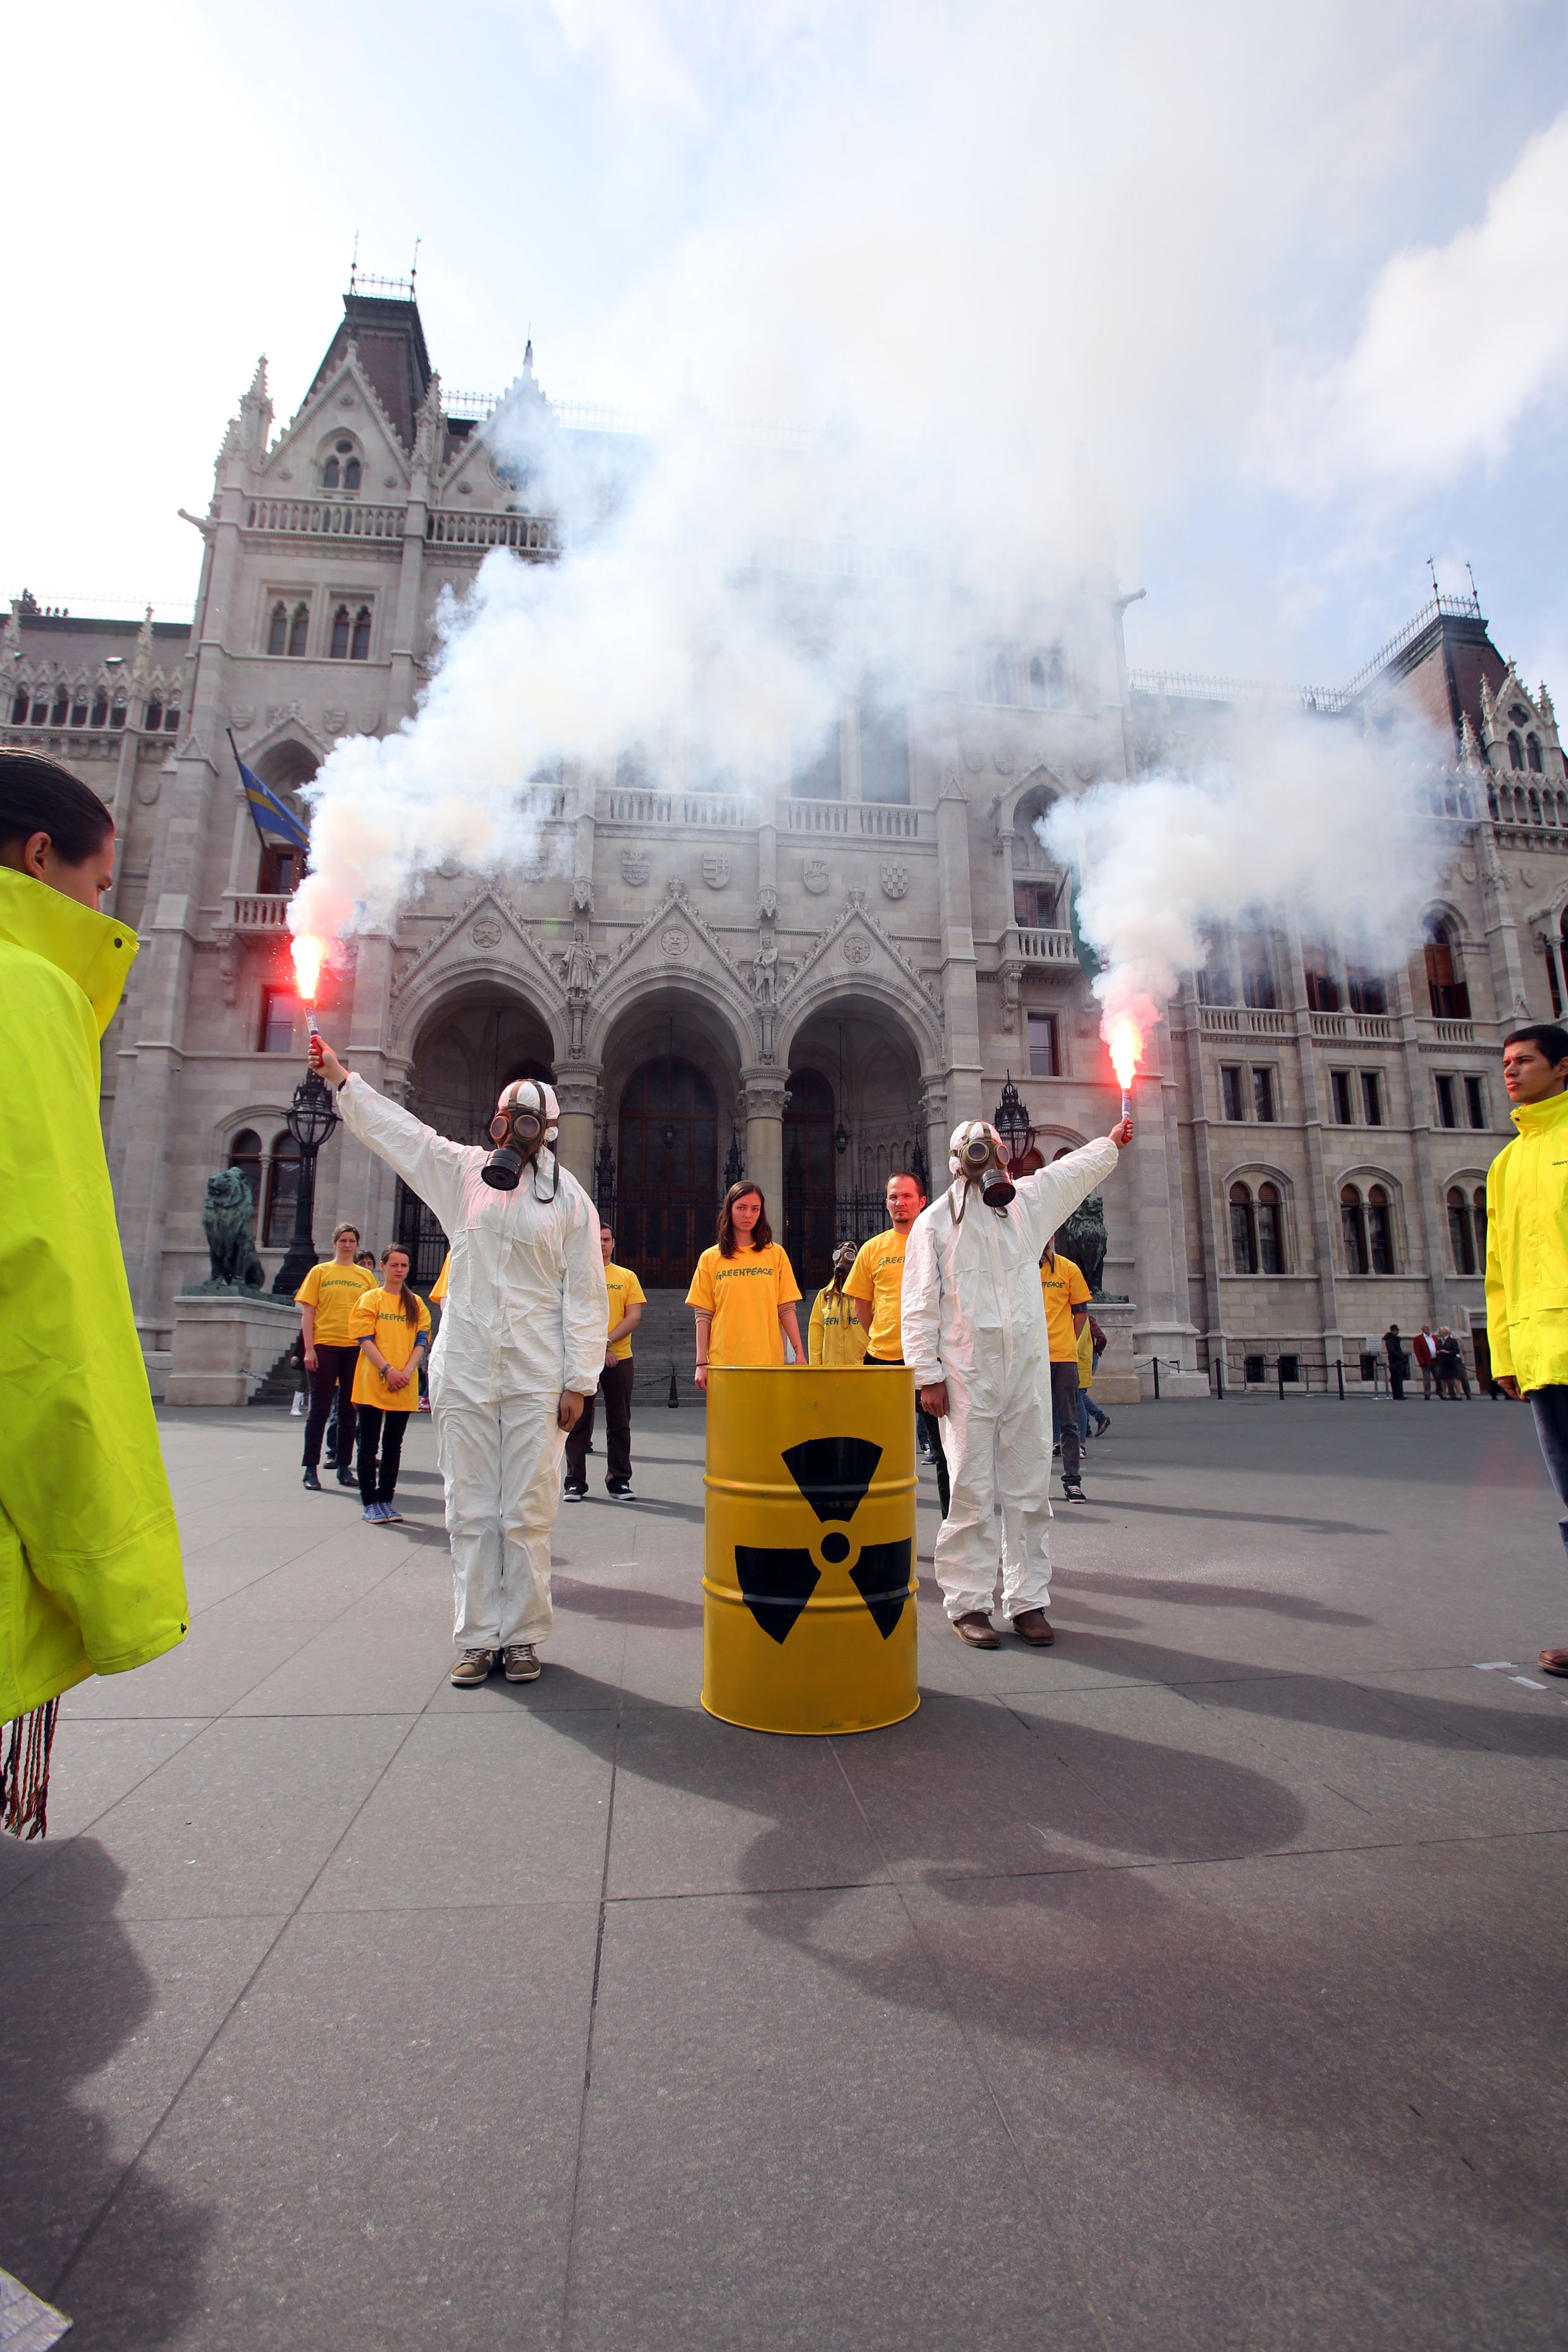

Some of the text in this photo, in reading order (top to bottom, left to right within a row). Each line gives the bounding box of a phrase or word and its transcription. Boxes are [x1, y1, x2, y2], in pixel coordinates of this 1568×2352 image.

[716, 1268, 773, 1280] GREENPEACE
[321, 1280, 362, 1288] GREENPEACE
[824, 1317, 839, 1325] EEN
